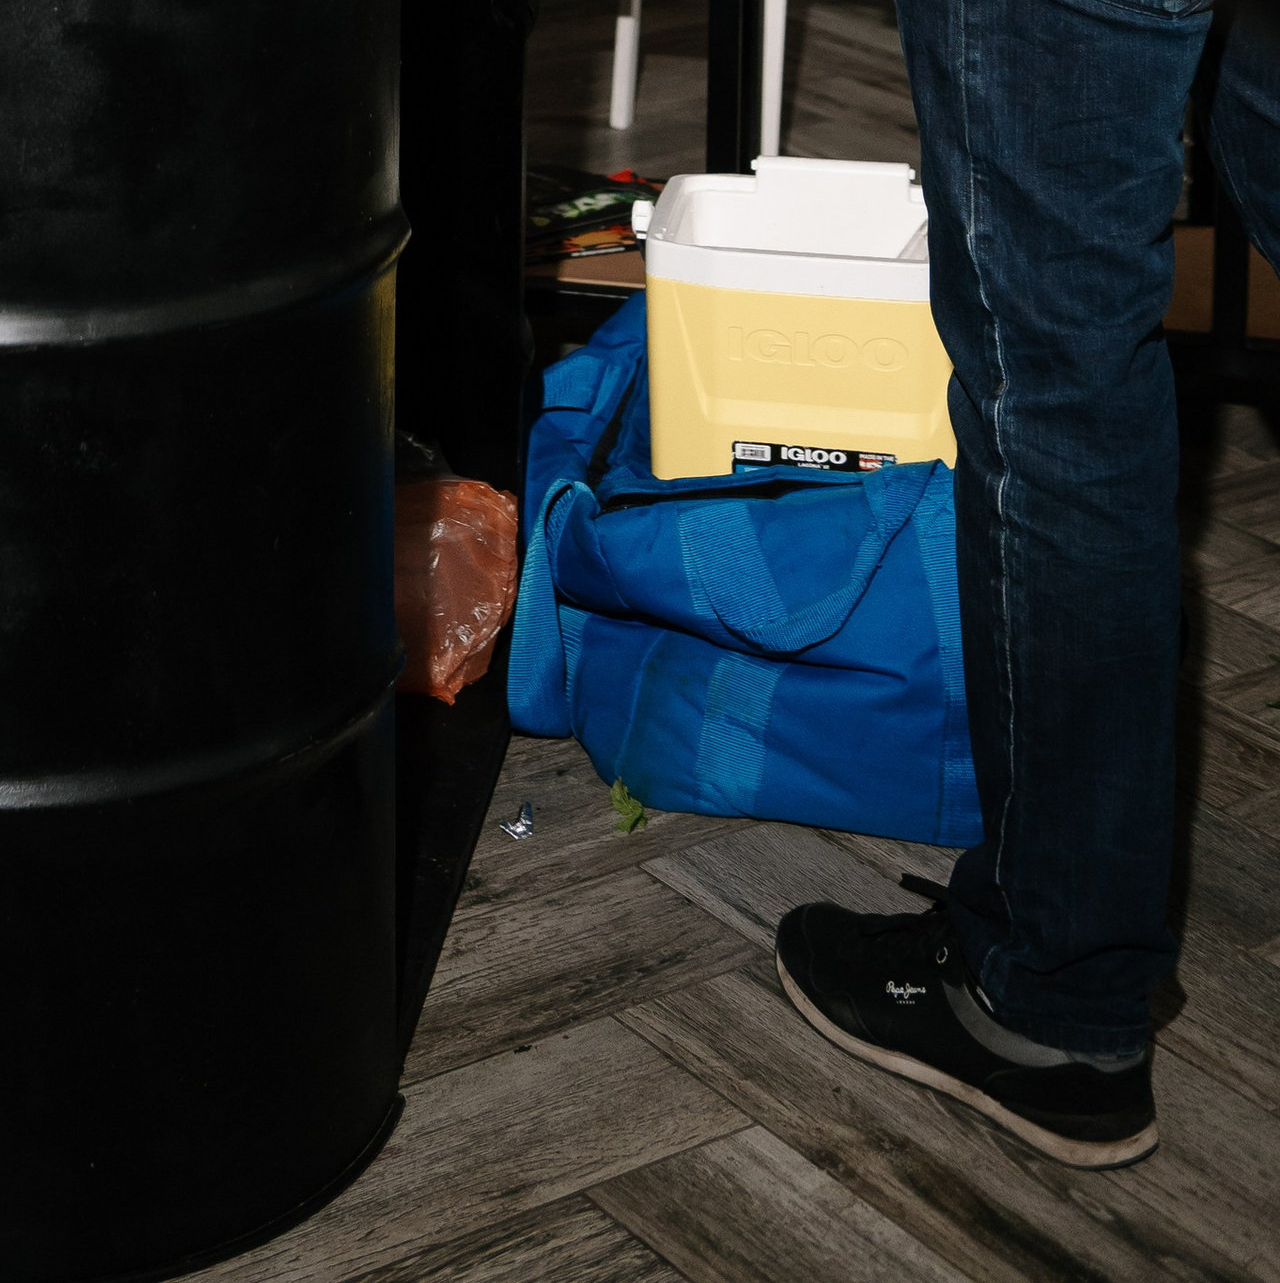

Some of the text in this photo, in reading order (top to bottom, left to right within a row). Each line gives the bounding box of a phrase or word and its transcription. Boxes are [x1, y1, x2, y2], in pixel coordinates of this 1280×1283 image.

[728, 325, 910, 373] IGLOO
[780, 446, 847, 465] IGLOO
[903, 982, 926, 999] Jeans
